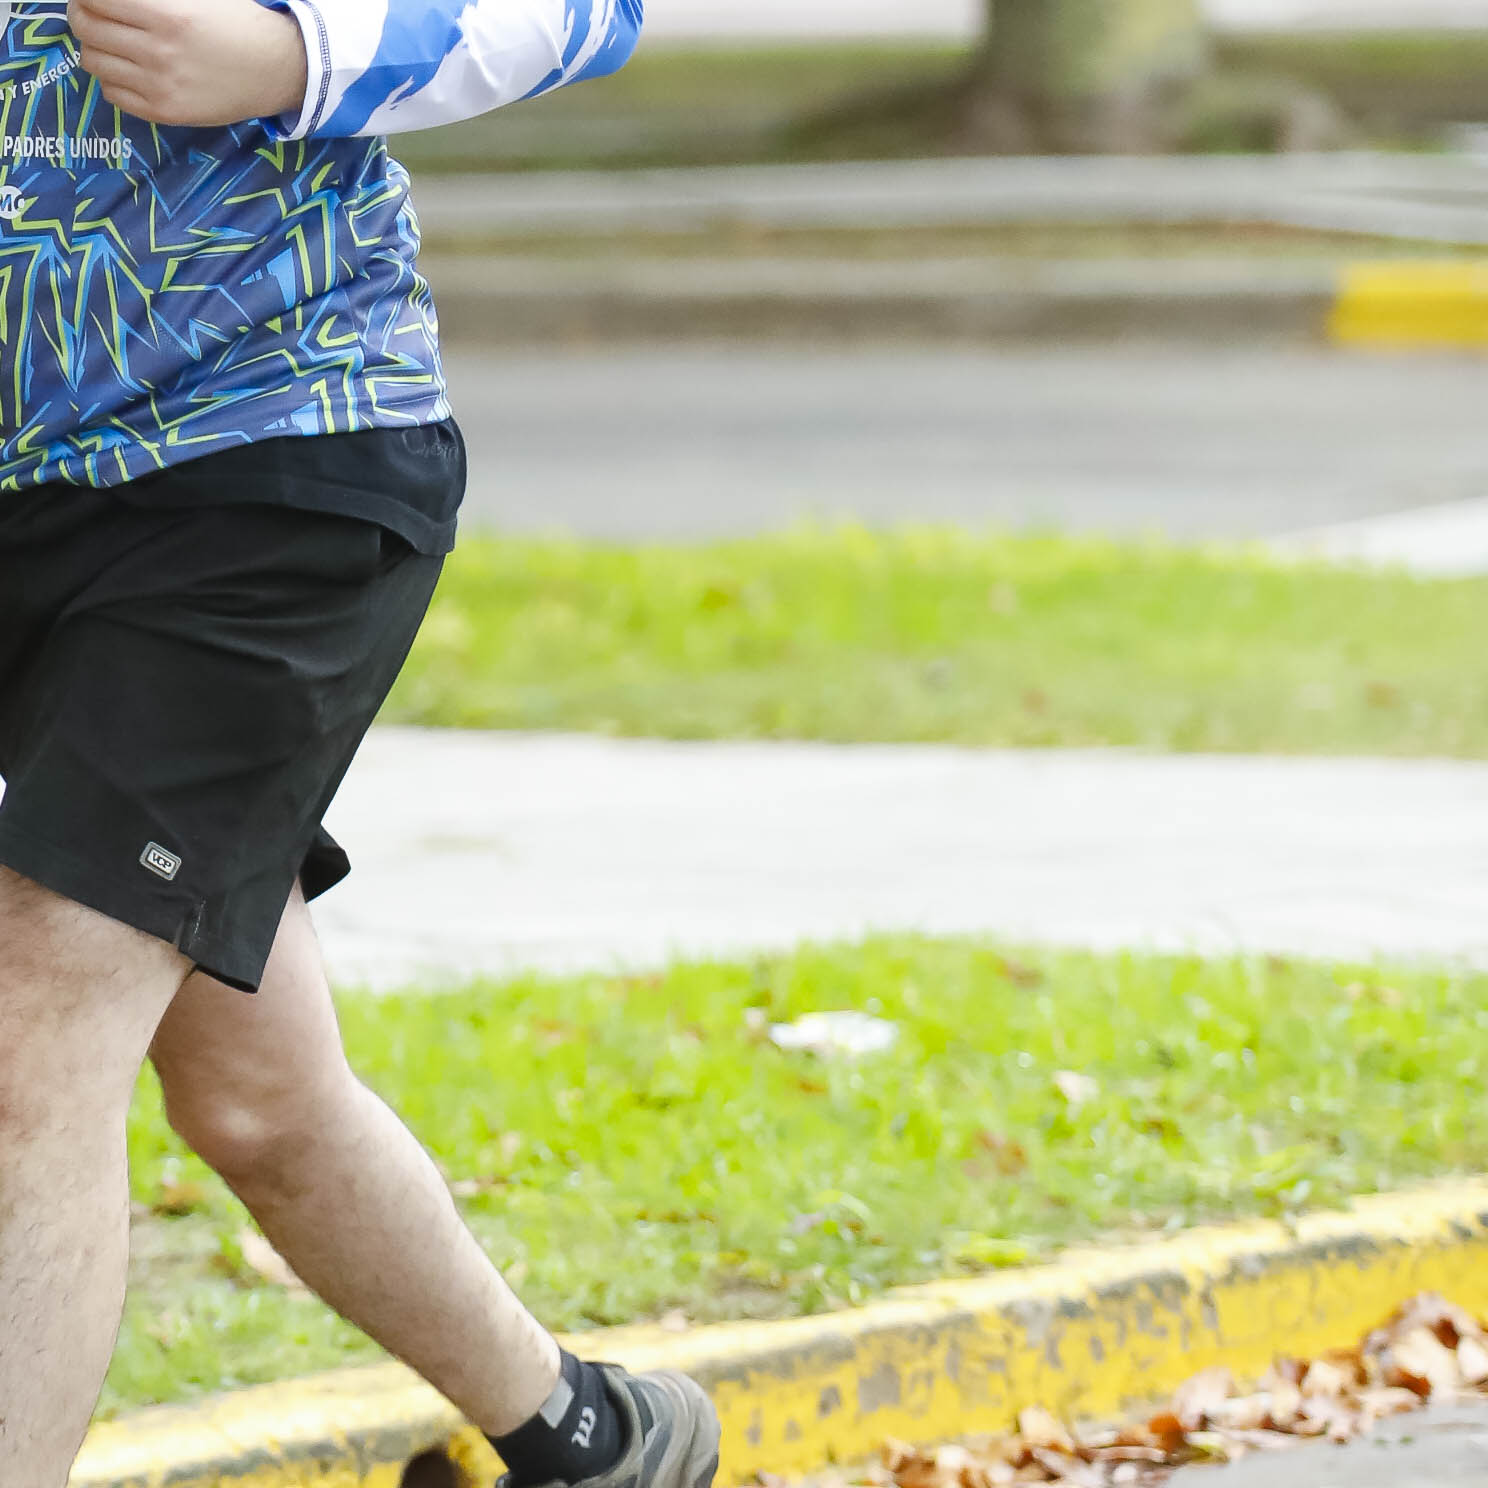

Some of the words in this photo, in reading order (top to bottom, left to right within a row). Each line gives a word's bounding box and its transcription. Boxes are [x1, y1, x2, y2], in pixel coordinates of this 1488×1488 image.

[8, 85, 18, 99] Y
[4, 136, 65, 158] PADRES
[70, 137, 132, 159] UNIDOS
